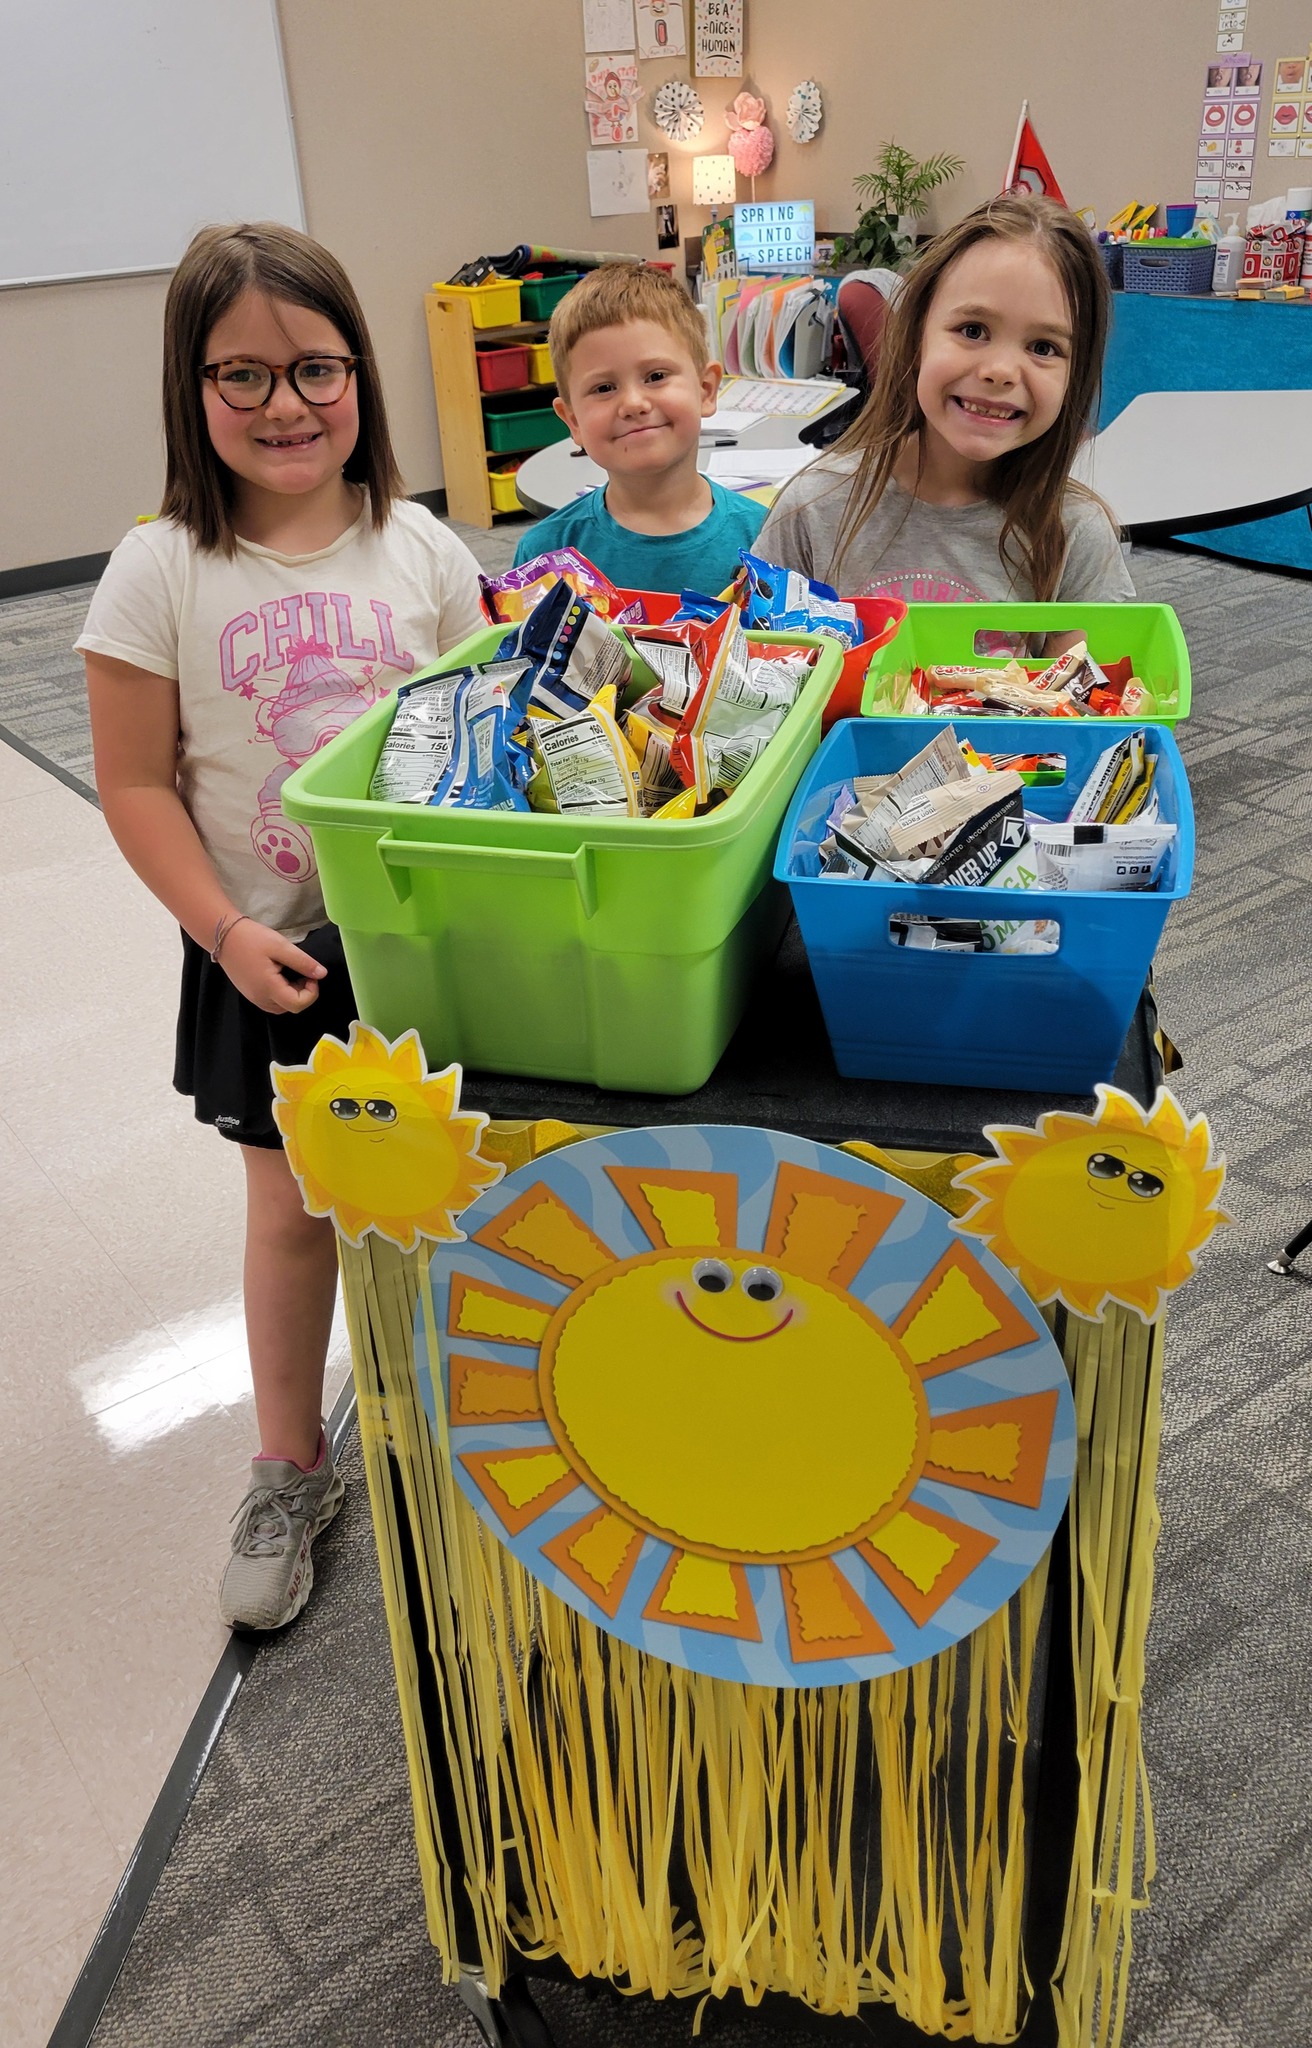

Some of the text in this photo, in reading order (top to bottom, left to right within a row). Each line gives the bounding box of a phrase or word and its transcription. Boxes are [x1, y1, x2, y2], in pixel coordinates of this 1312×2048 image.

[708, 2, 730, 16] BE A
[701, 38, 736, 53] HUMAN
[741, 205, 794, 223] SPRING
[758, 227, 792, 243] INTO
[757, 246, 812, 264] SPEECH
[911, 579, 976, 603] GIRL
[219, 592, 415, 692] CHILL
[384, 741, 449, 751] Calories 150
[544, 734, 580, 752] Calories
[942, 841, 998, 887] WER UP
